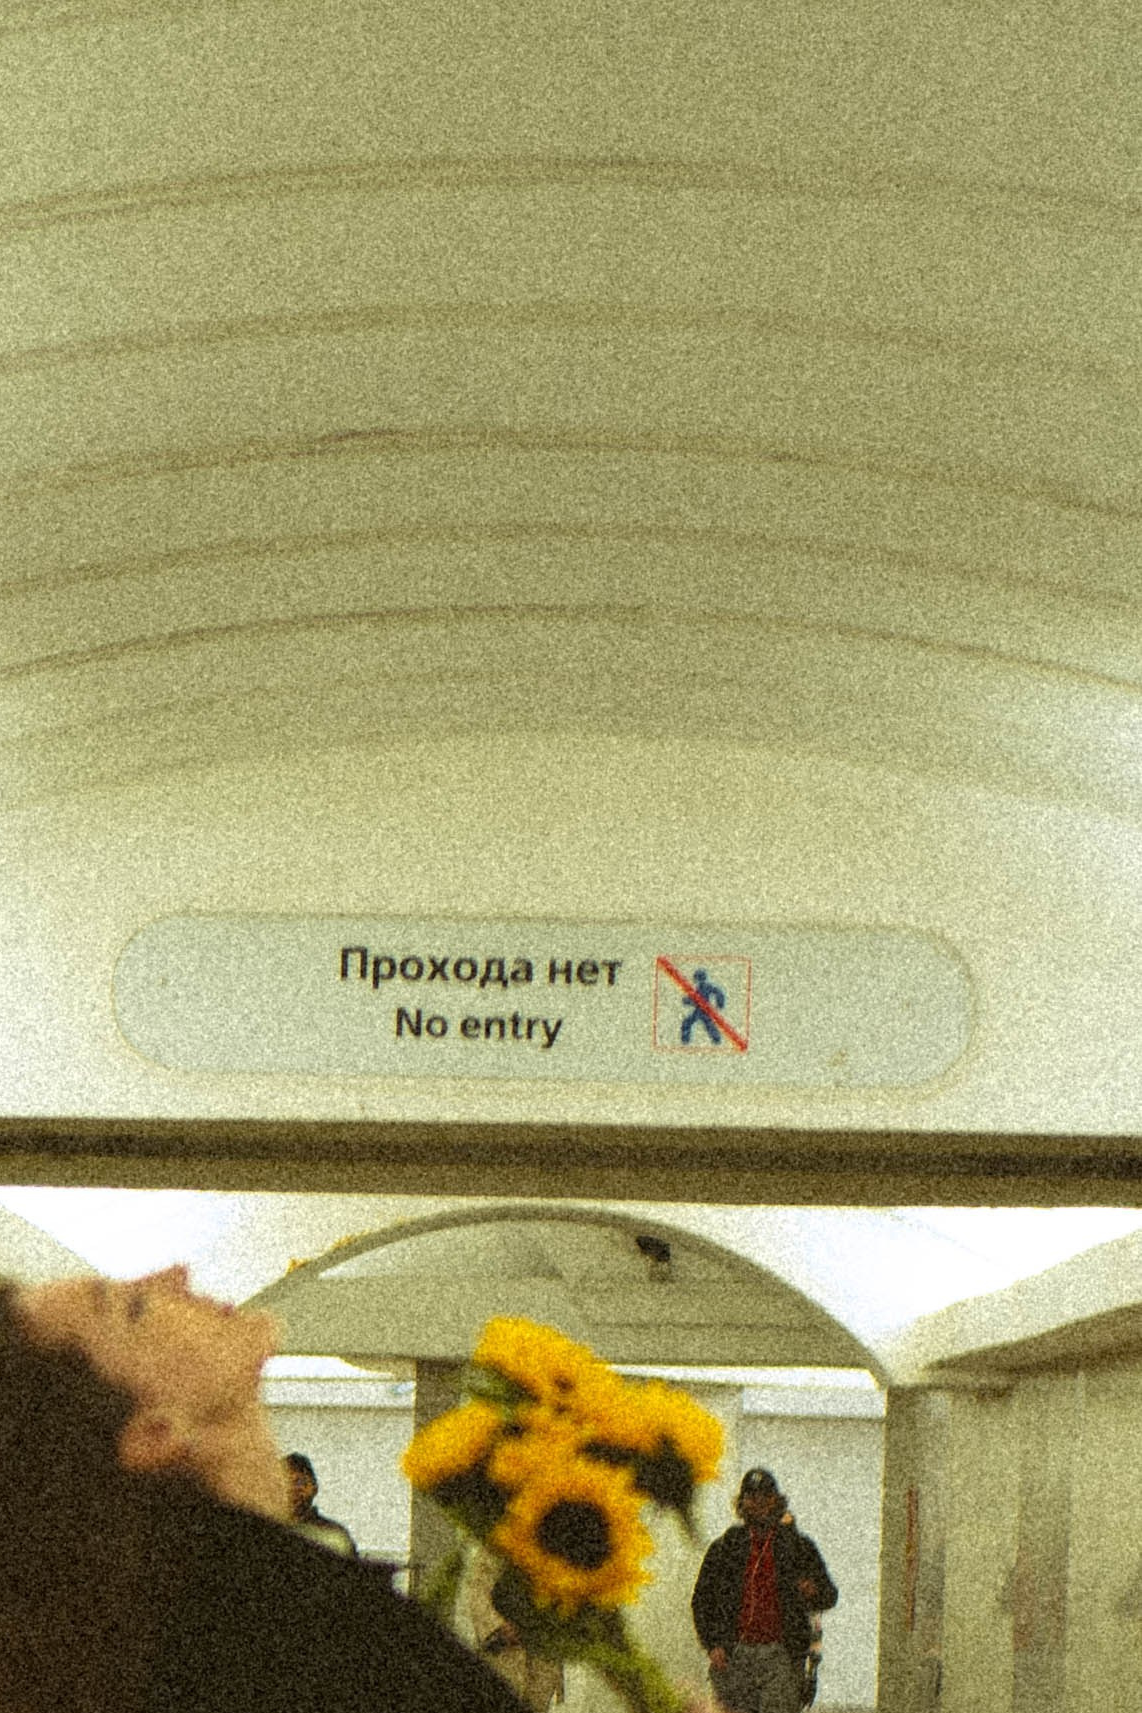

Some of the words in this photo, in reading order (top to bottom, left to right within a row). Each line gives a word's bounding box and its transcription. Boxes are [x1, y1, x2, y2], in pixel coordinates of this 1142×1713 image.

[340, 946, 533, 988] Прохода
[548, 956, 622, 986] нет
[395, 1007, 448, 1037] No
[460, 1011, 563, 1048] entry
